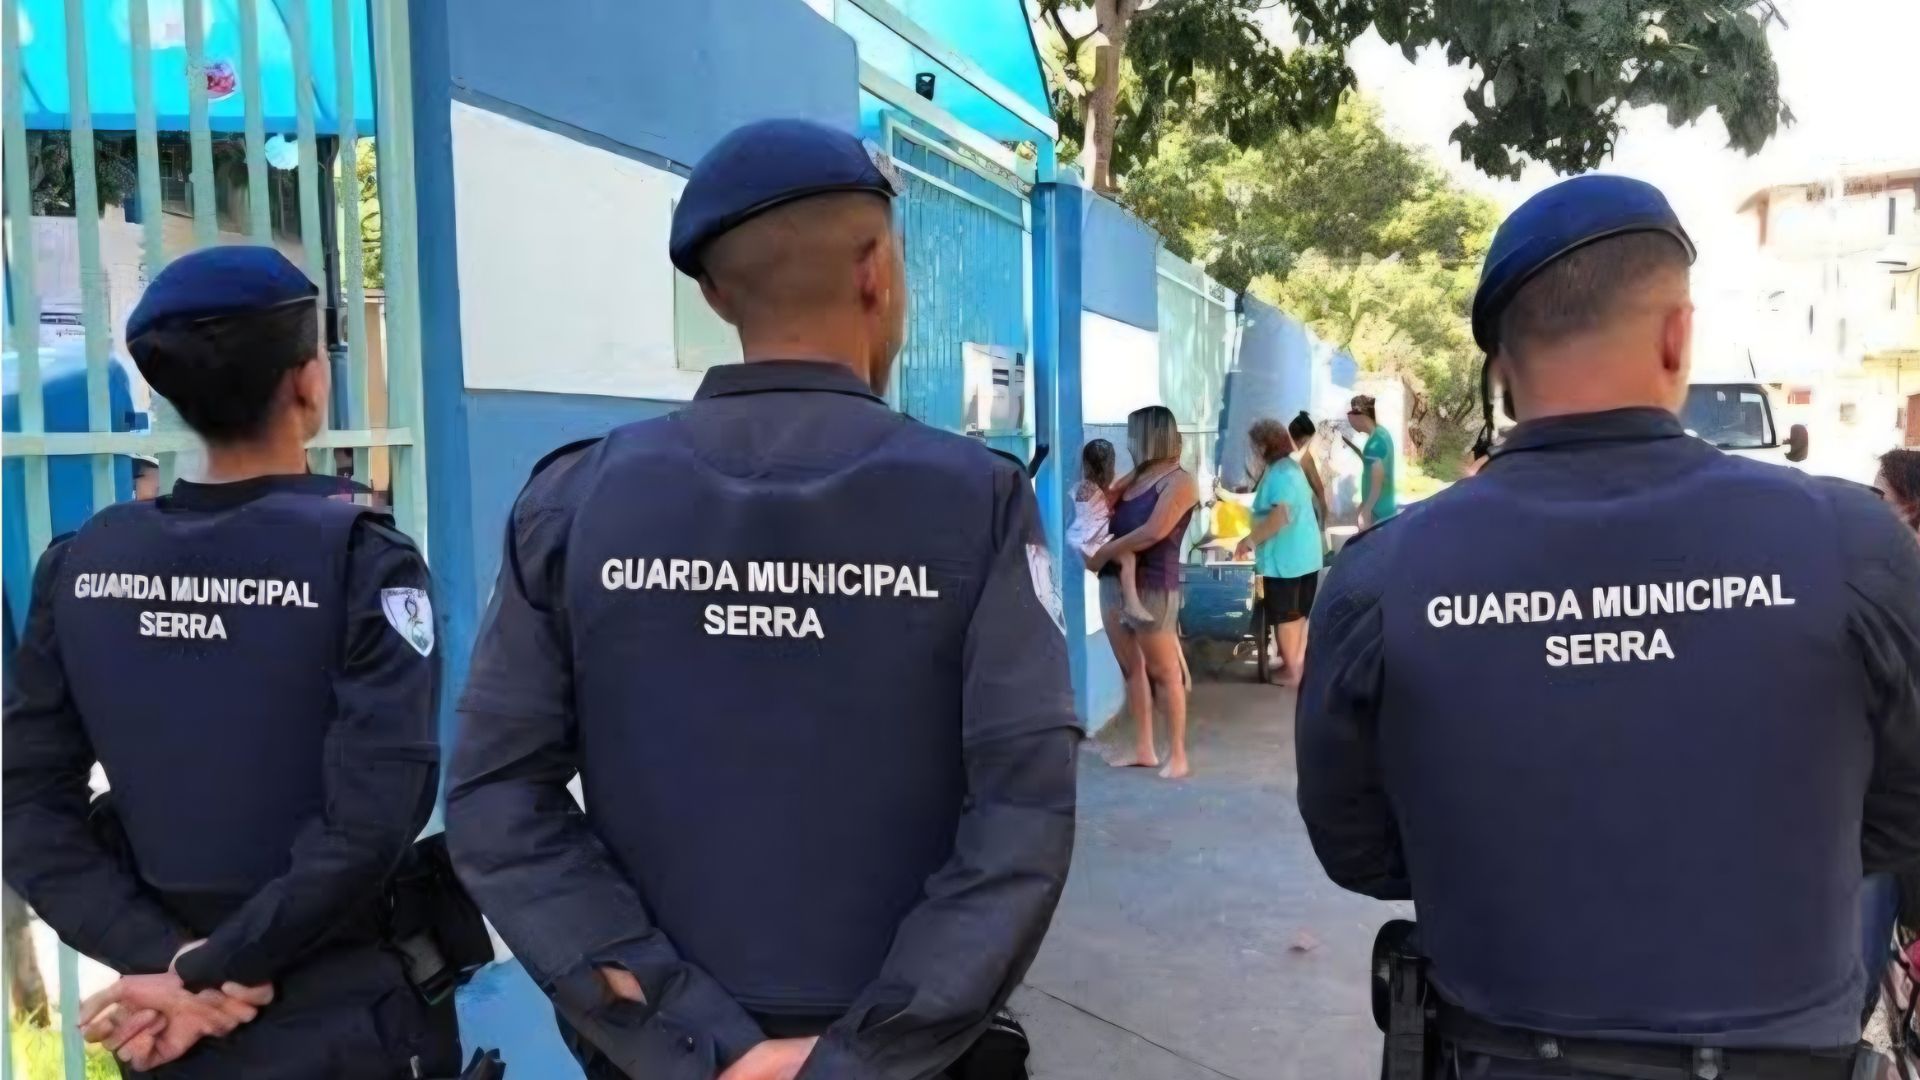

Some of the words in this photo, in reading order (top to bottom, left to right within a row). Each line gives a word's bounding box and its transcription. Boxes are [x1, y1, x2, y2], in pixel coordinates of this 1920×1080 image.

[74, 572, 166, 601] GUARDA
[171, 576, 320, 609] MUNICIPAL
[601, 558, 740, 593] GUARDA
[747, 561, 939, 599] MUNICIPAL
[1426, 588, 1583, 628] GUARDA
[1592, 573, 1797, 619] MUNICIPAL
[139, 611, 228, 640] SERRA
[703, 603, 825, 640] SERRA
[1545, 629, 1676, 667] SERRA
